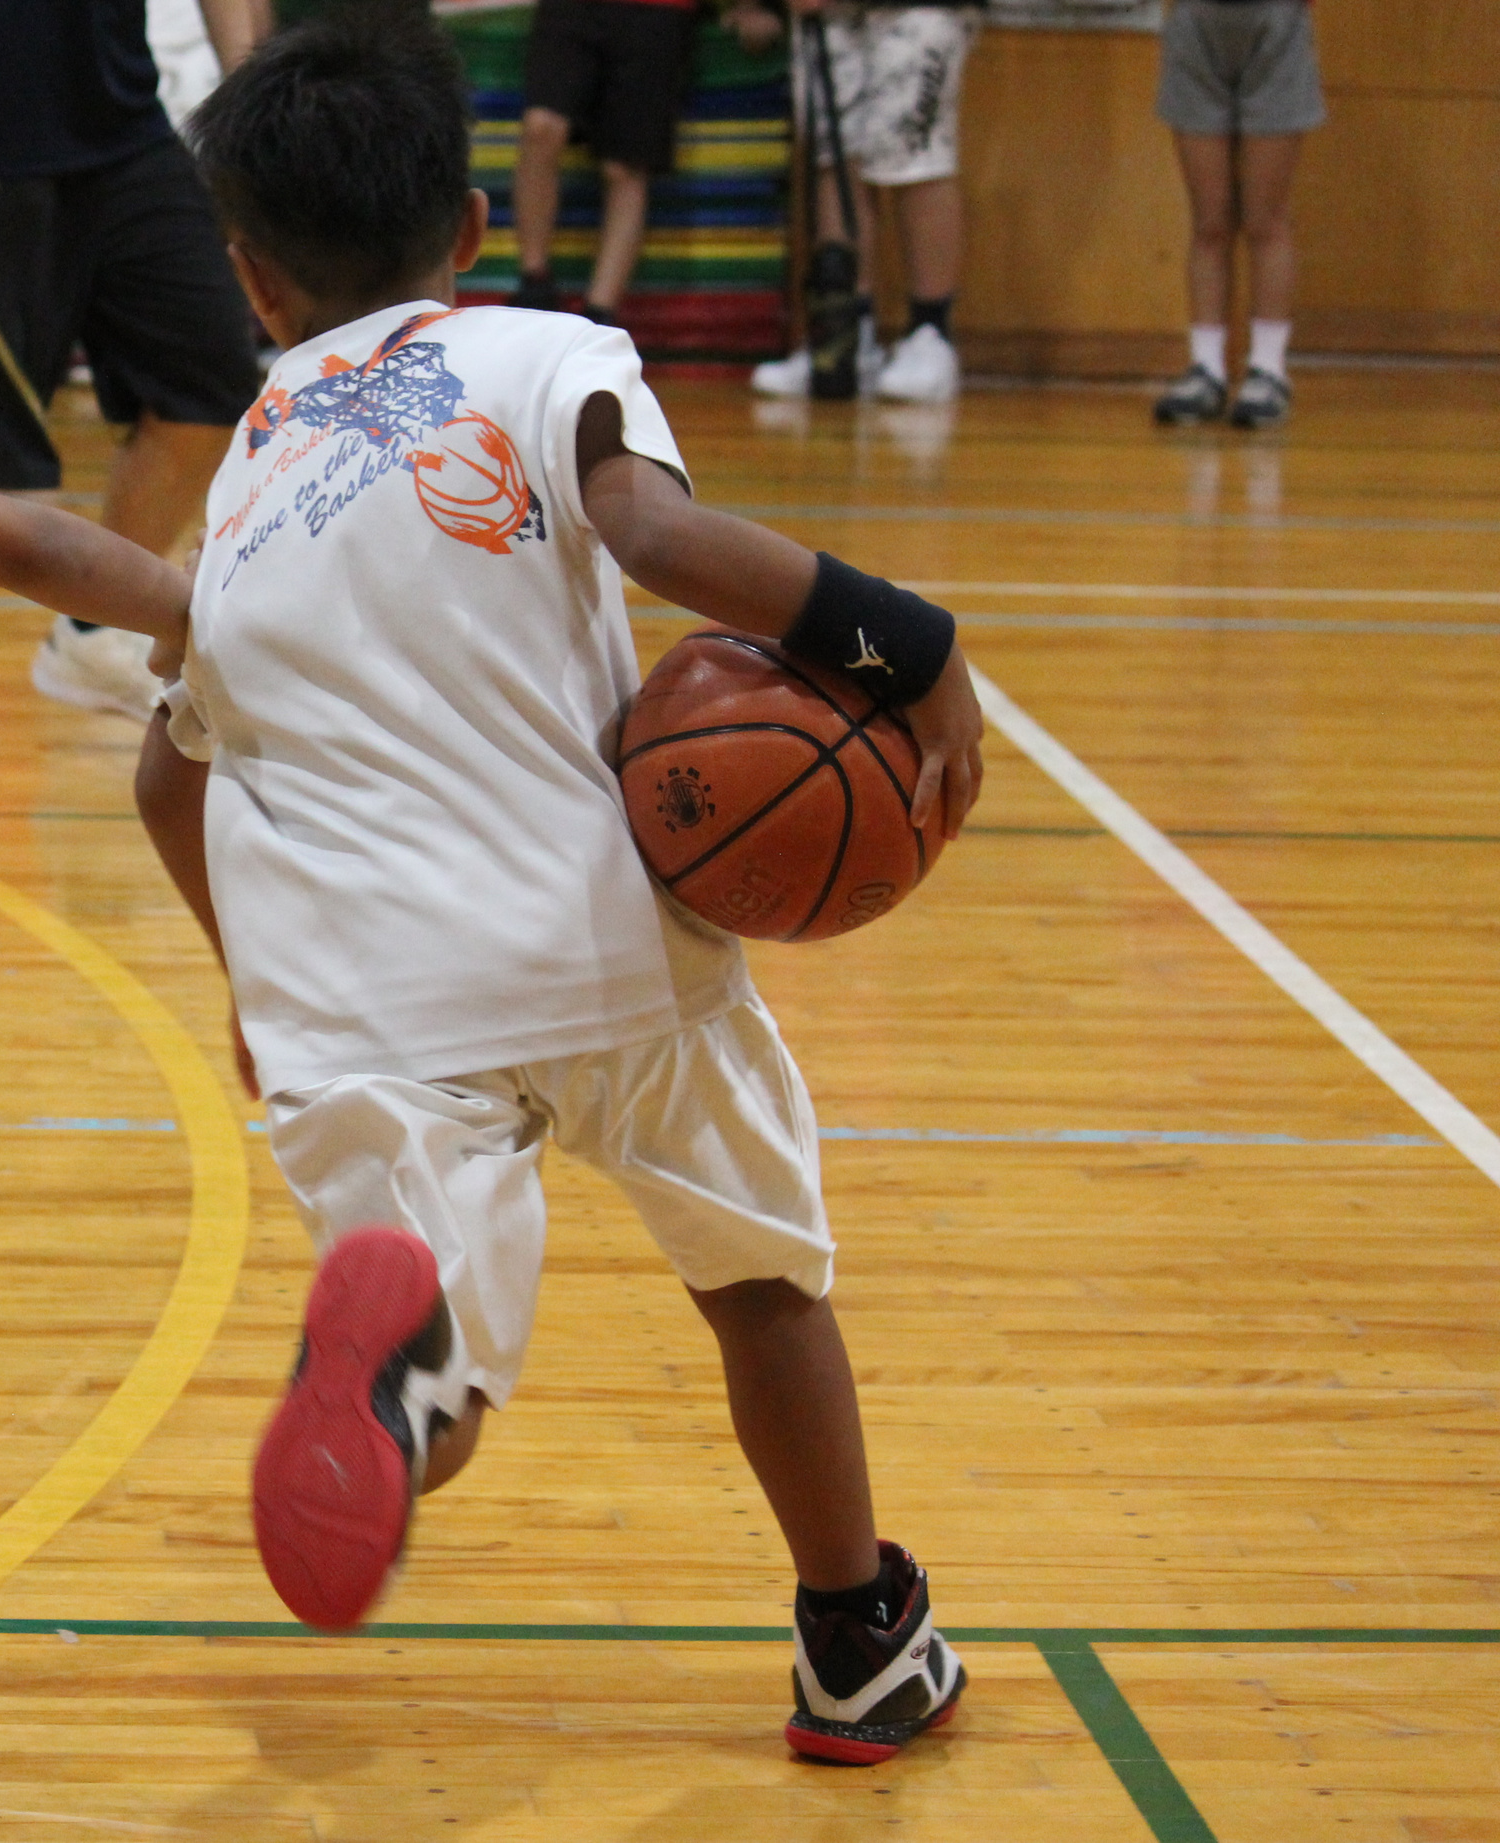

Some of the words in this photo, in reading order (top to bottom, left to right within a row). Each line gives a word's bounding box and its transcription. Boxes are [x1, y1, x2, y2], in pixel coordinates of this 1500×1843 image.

[294, 479, 319, 513] to
[324, 433, 364, 483] the
[304, 435, 404, 538] Basket
